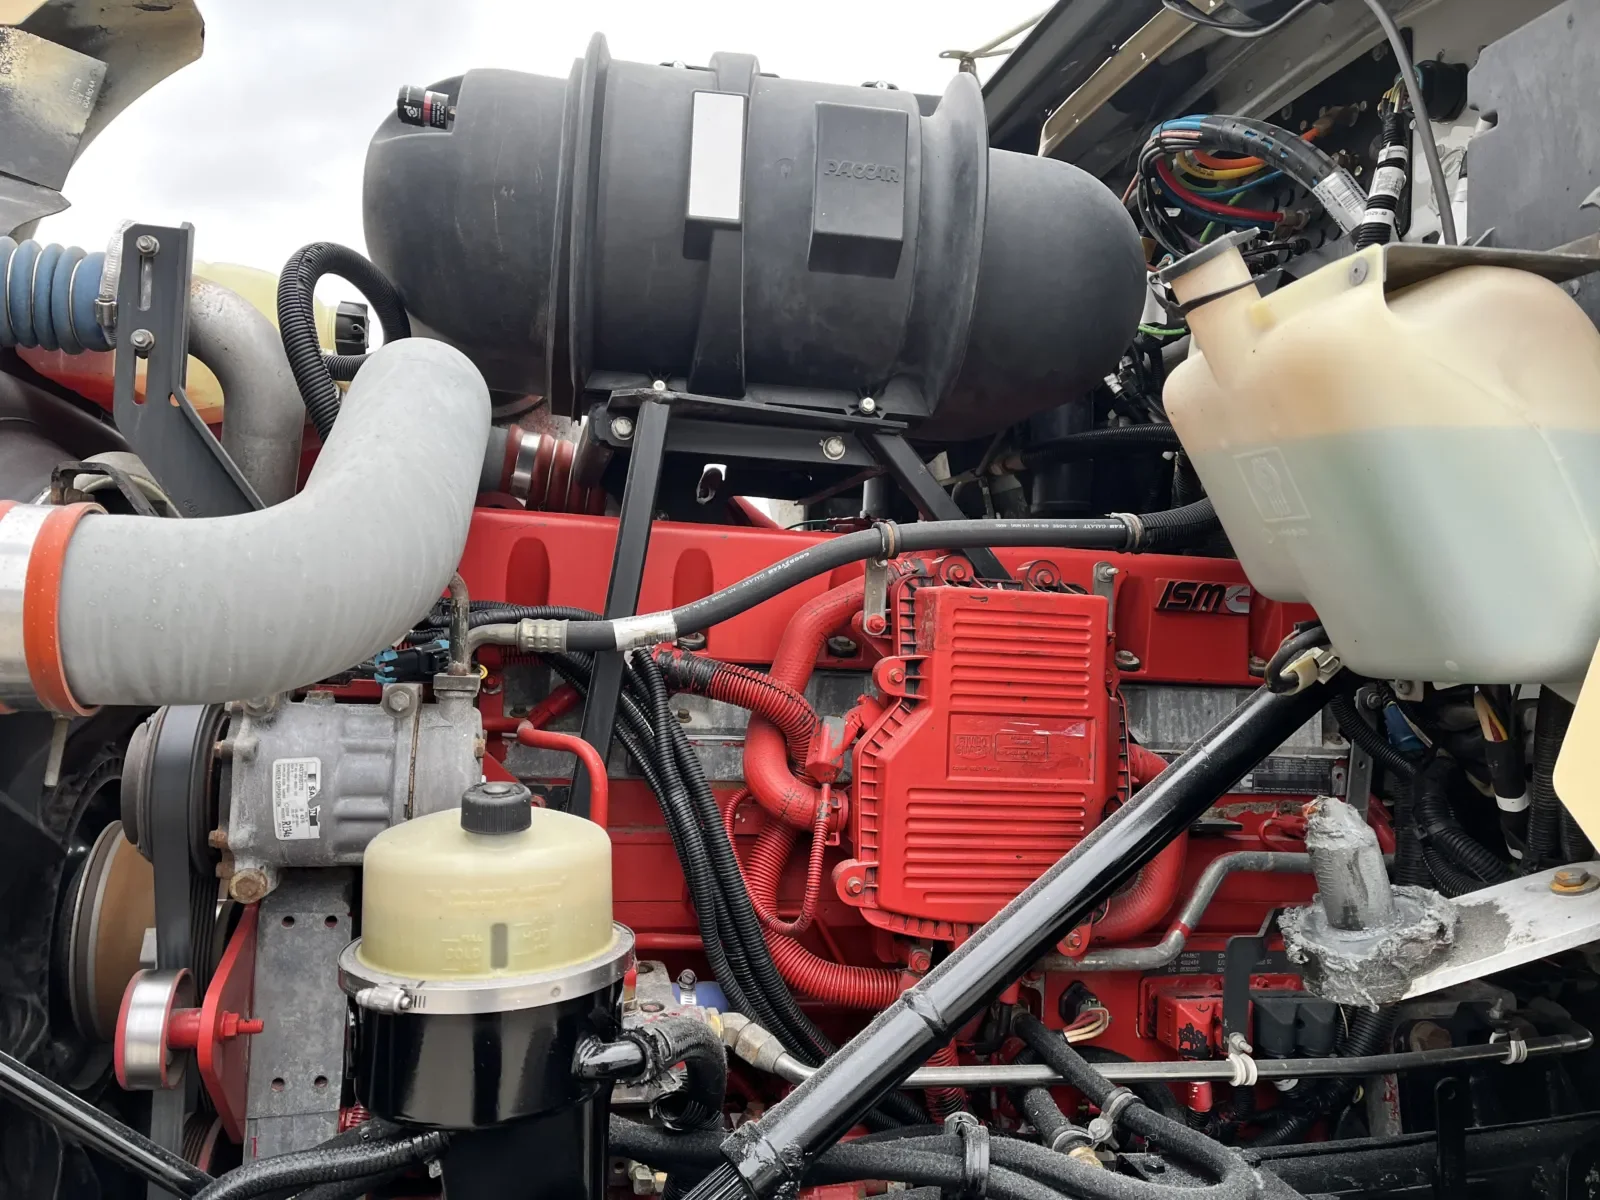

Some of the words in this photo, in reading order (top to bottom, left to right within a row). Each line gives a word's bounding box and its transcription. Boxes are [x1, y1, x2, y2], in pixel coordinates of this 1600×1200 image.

[823, 158, 900, 184] PACCAR
[767, 551, 810, 575] GOODYEAR
[1157, 580, 1227, 612] ISM
[445, 947, 482, 960] COLD
